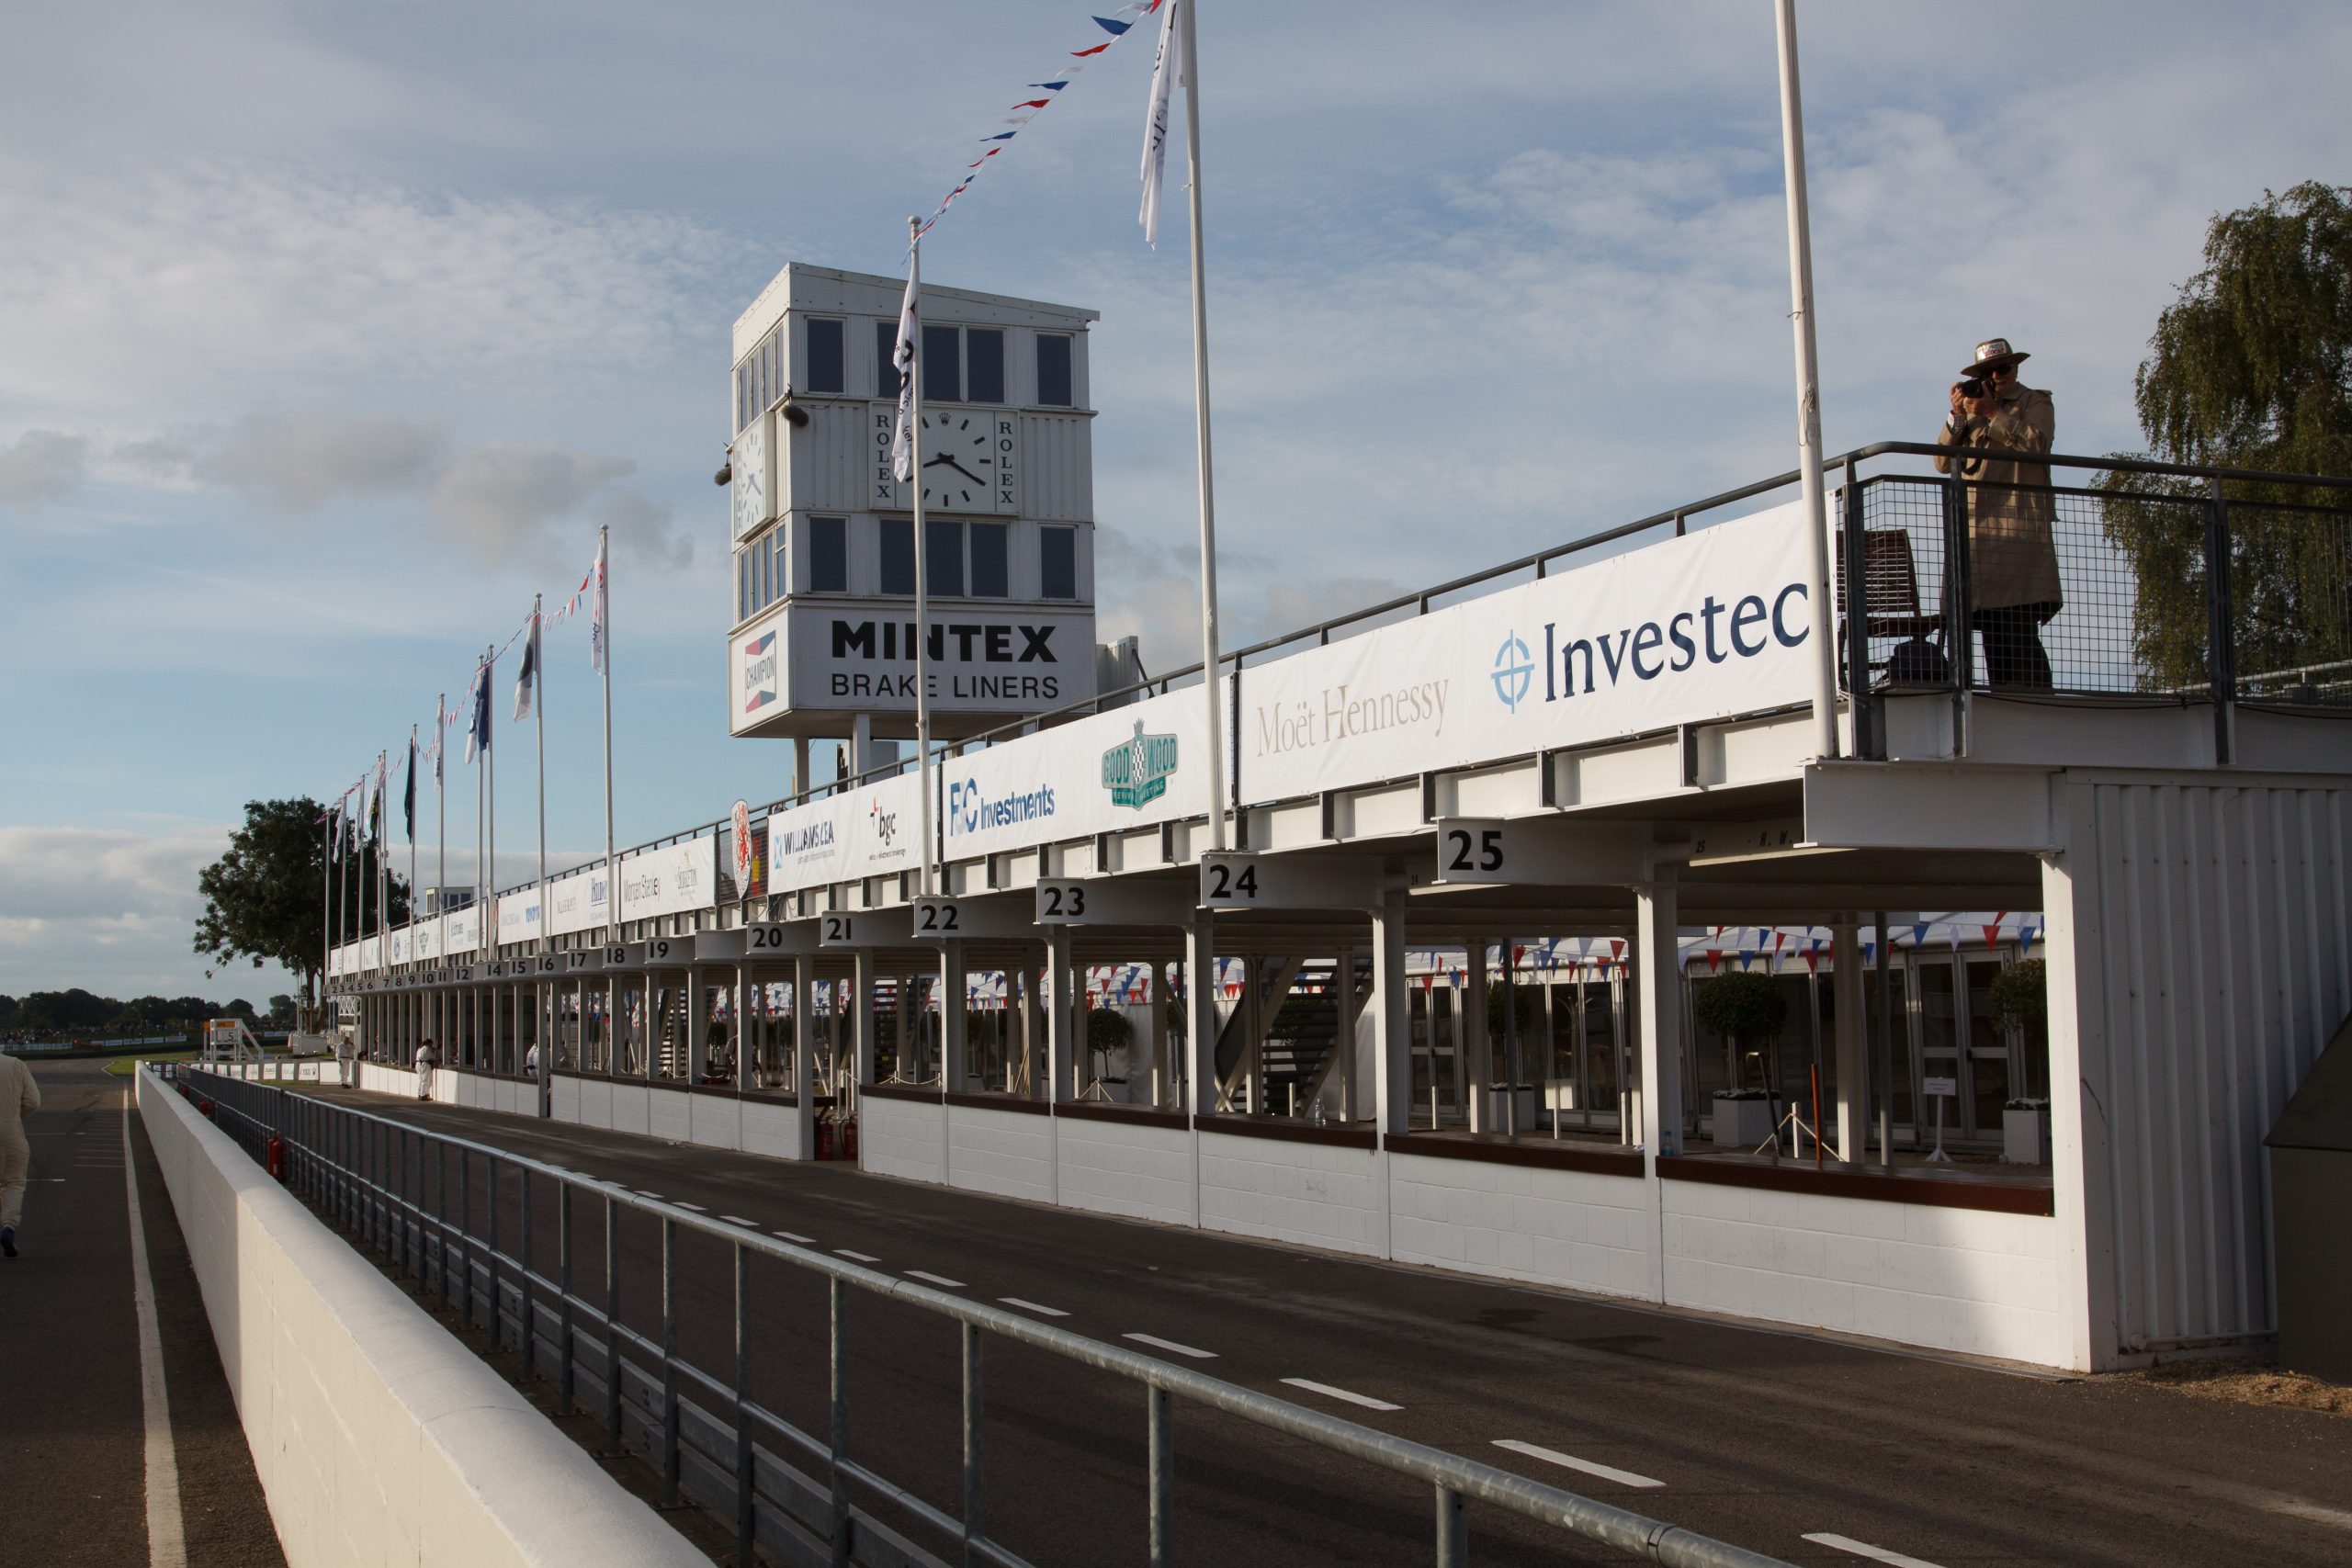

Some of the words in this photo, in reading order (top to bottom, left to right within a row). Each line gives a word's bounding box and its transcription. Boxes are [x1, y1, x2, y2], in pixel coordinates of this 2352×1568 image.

[876, 414, 891, 498] ROLEX
[999, 422, 1014, 503] ROLEX
[831, 620, 1058, 662] MINTEX
[1544, 582, 1810, 703] Investec
[746, 653, 775, 690] CHAMPION
[831, 673, 937, 697] BRAKE
[954, 675, 1059, 699] LINERS
[1257, 701, 1316, 757] Moët
[1322, 679, 1450, 744] Hennessy
[1103, 746, 1130, 784] GOOD
[1147, 738, 1176, 777] WOOD
[1139, 781, 1164, 802] MEETING
[980, 783, 1055, 829] Investments
[820, 819, 834, 845] LEA
[879, 807, 896, 846] bgc
[1448, 829, 1504, 872] 25
[624, 879, 641, 908] Morgan
[641, 871, 661, 902] Stanley
[1209, 863, 1258, 898] 24
[1044, 886, 1085, 917] 23
[921, 905, 958, 931] 22
[752, 927, 783, 948] 20
[827, 918, 852, 941] 21
[571, 952, 587, 967] 17
[606, 947, 626, 964] 18
[650, 941, 669, 959] 19
[456, 968, 469, 980] 12
[487, 964, 502, 976] 14
[512, 961, 526, 974] 15
[538, 957, 555, 971] 16
[356, 983, 363, 991] 5
[367, 981, 373, 990] 6
[383, 978, 390, 987] 7
[395, 977, 402, 987] 8
[408, 976, 415, 985] 9
[422, 973, 435, 984] 10
[438, 971, 447, 982] 11
[332, 986, 337, 994] 2
[339, 985, 345, 993] 3
[347, 984, 354, 992] 4
[228, 1032, 234, 1041] 5
